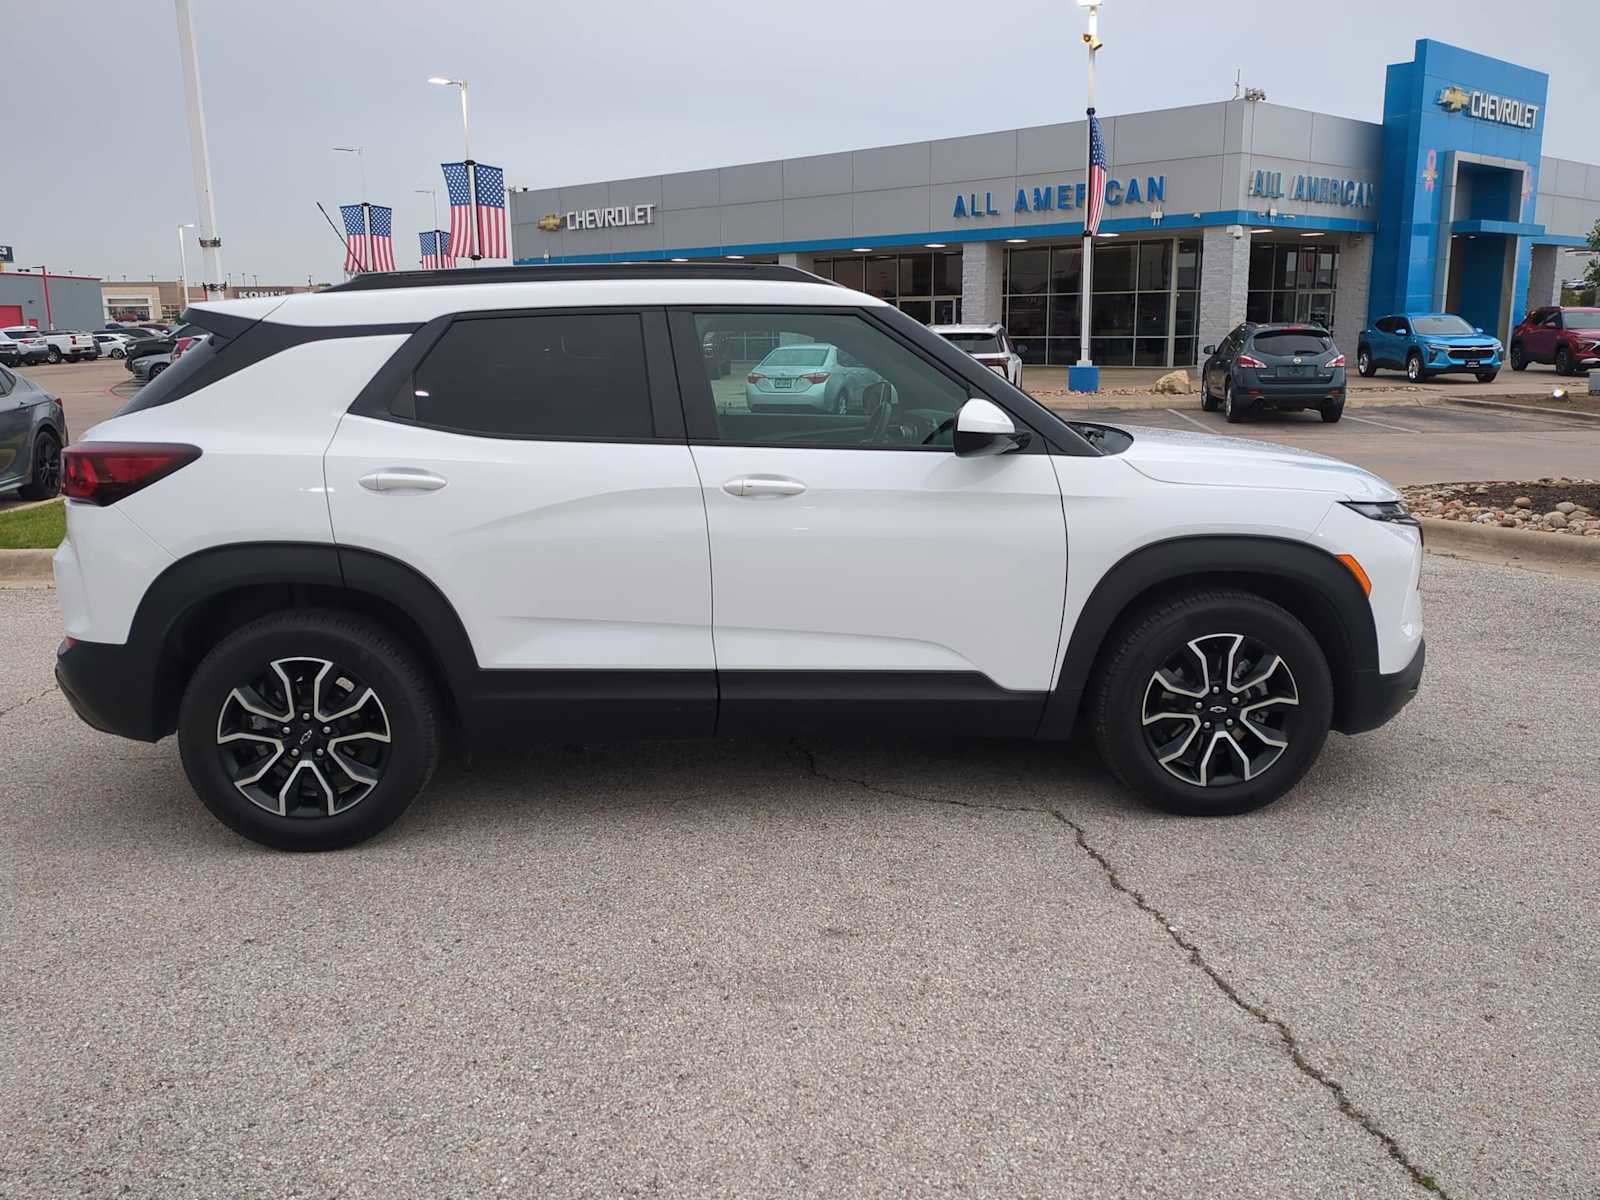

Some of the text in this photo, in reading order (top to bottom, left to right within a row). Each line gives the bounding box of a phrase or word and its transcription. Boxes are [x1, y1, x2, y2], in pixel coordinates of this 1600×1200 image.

[1471, 91, 1538, 128] CHEVROLET
[953, 175, 1167, 217] ALL AMERCAN
[1250, 169, 1284, 197] ALL
[566, 204, 655, 230] CHEVROLET
